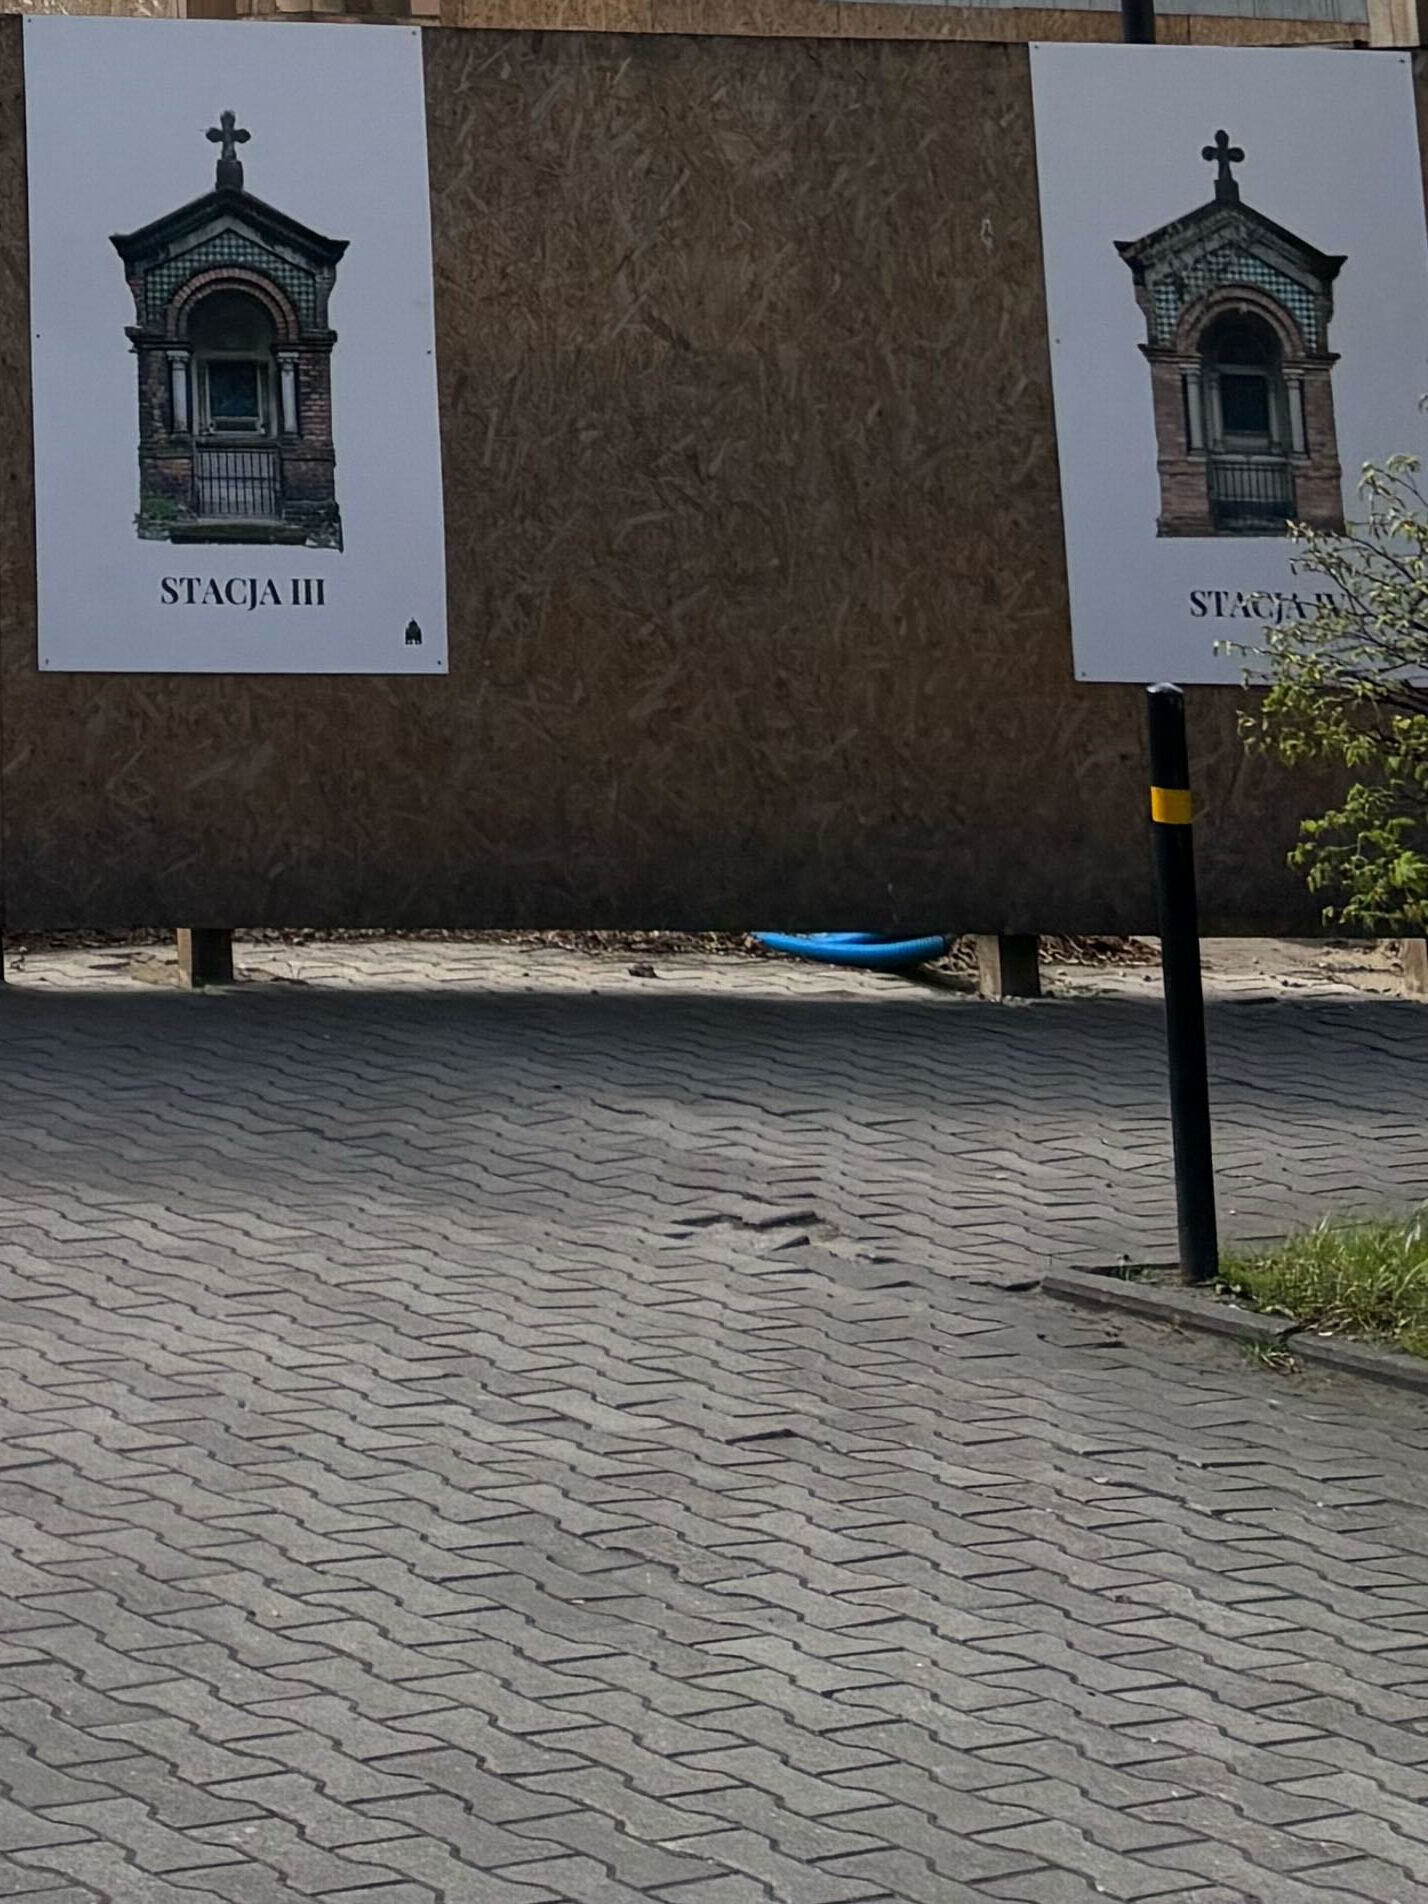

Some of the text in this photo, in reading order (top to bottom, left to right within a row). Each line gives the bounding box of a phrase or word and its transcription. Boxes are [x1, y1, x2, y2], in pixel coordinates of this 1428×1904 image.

[160, 576, 325, 612] STACJA III
[1190, 590, 1307, 624] STACJA
